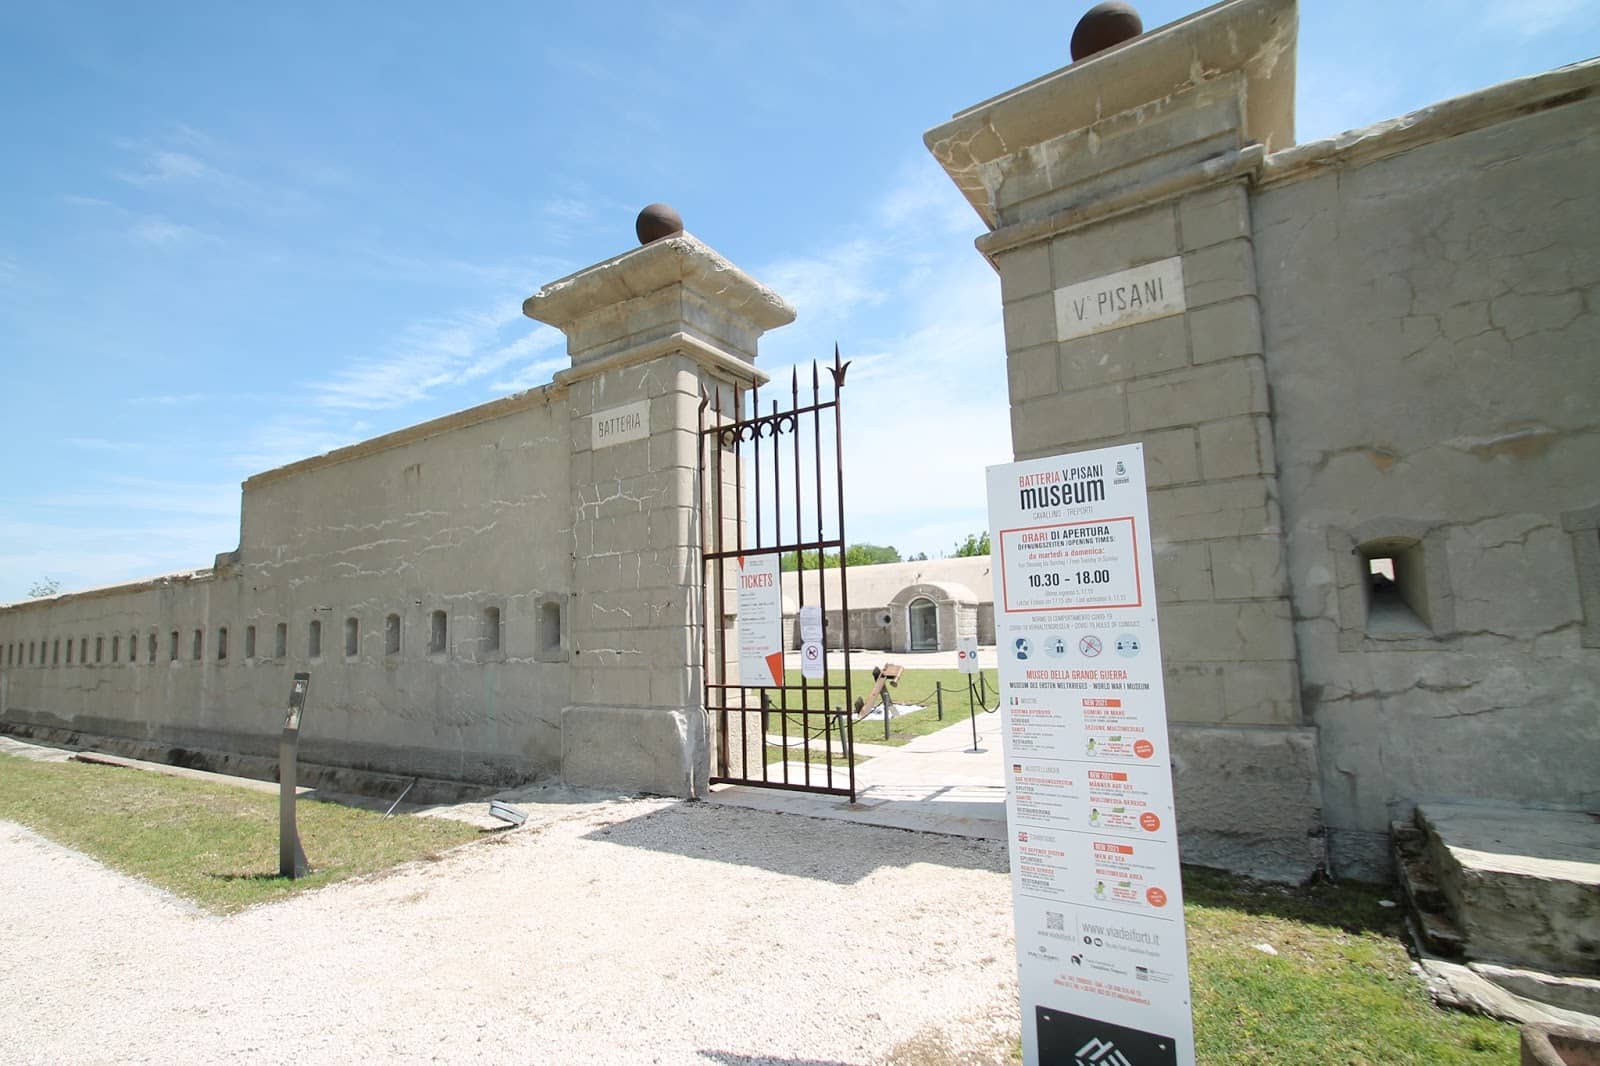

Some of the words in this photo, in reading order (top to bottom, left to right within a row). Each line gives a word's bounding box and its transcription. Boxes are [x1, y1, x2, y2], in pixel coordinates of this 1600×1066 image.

[1097, 277, 1163, 315] PISANI
[598, 412, 641, 438] BATTERIA
[1019, 471, 1060, 487] BATTERIA
[1062, 464, 1103, 481] V.PISANI
[1020, 479, 1105, 510] museum
[1022, 532, 1048, 543] ORARI
[1050, 530, 1060, 541] DI
[1063, 526, 1110, 539] APERTURA
[1029, 552, 1037, 560] da
[741, 573, 773, 588] TICKETS
[1029, 573, 1060, 588] 10.30
[1075, 569, 1110, 585] 18.00
[1026, 670, 1049, 680] MUSEO
[1050, 670, 1070, 680] DELLA
[1071, 670, 1098, 680] GRANDE
[1100, 670, 1127, 680] GUERRA
[1093, 682, 1110, 690] WORLD
